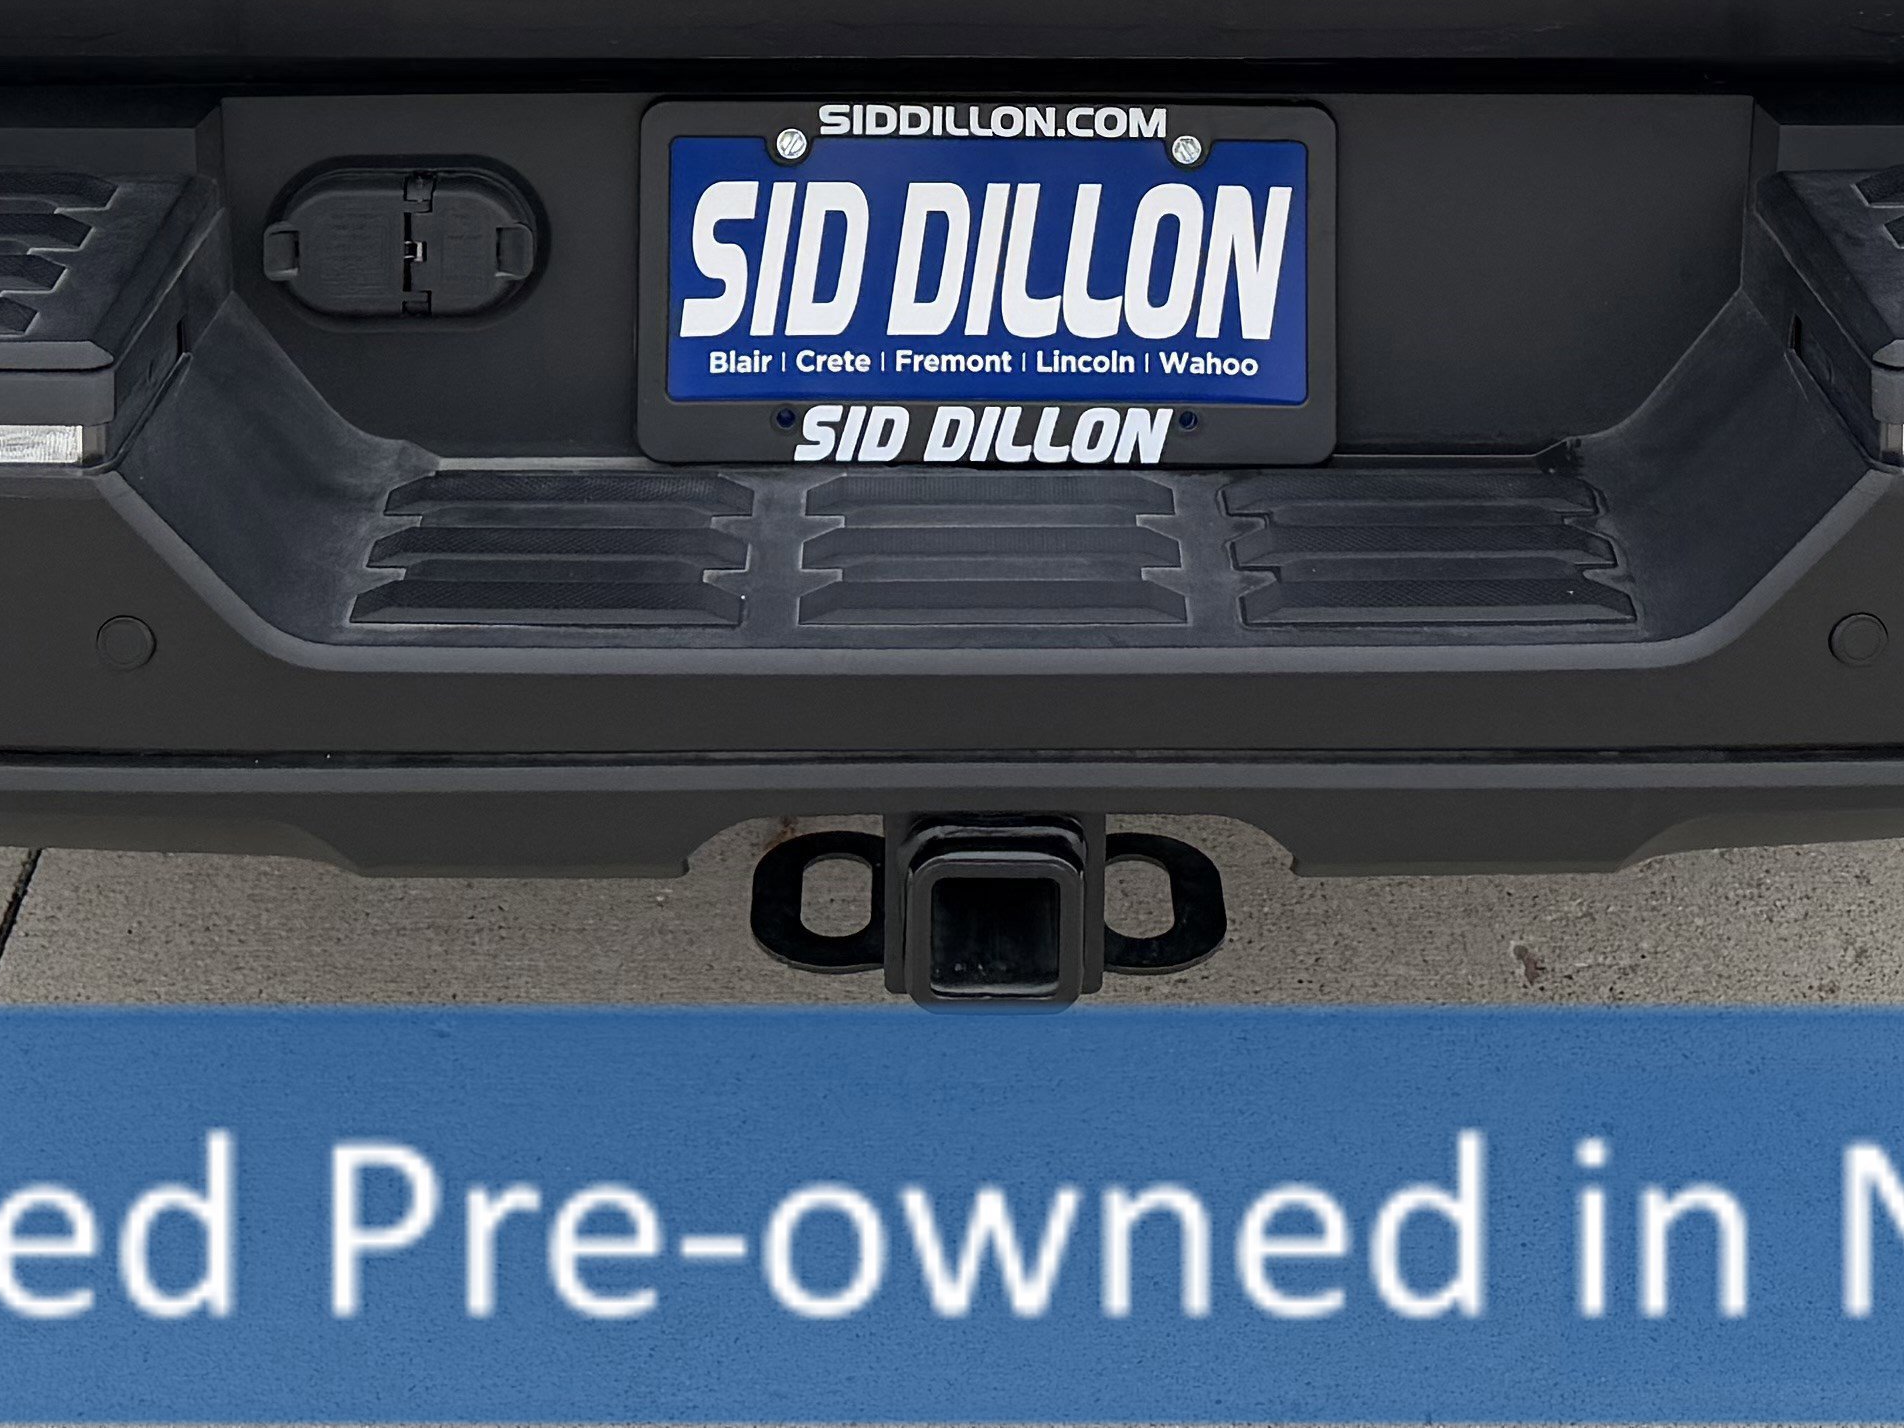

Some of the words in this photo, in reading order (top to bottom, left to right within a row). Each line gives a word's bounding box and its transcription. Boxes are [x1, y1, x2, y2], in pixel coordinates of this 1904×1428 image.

[818, 104, 1168, 139] SIDDILLON.COM
[678, 180, 871, 338] SID
[886, 181, 1293, 340] DILLON
[709, 350, 773, 374] Blair
[795, 350, 872, 374] Crete
[894, 350, 1014, 375] Fremont
[1036, 350, 1136, 375] Lincoln
[1158, 351, 1260, 377] Wahoo
[794, 405, 909, 462] SID
[923, 406, 1174, 464] DILLON
